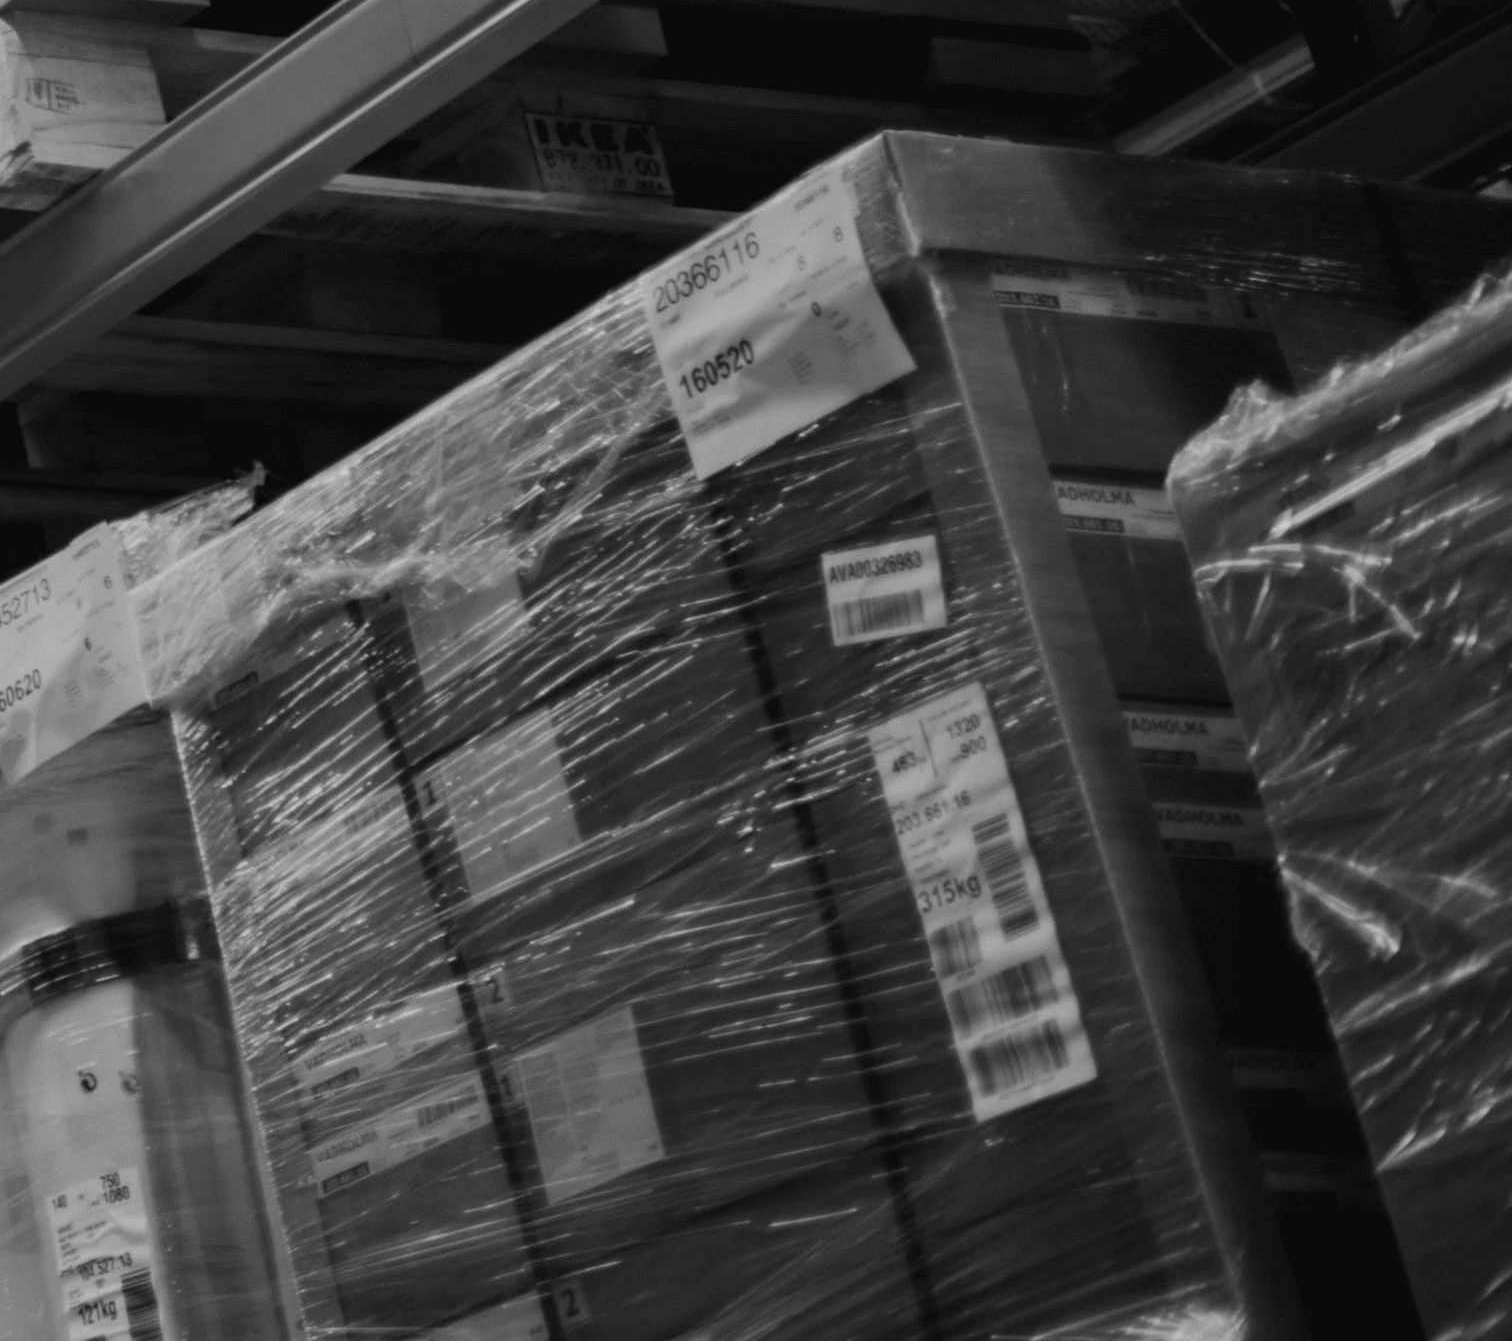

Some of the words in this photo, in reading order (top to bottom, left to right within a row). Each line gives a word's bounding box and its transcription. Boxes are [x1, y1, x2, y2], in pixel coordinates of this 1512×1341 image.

[533, 118, 657, 156] IKEA
[542, 148, 662, 179] 872.371.00
[653, 231, 761, 315] 20366116
[678, 338, 755, 400] 160520
[947, 713, 982, 742] 1320
[896, 789, 973, 836] 203.661.16
[918, 874, 984, 915] 315kg
[561, 1288, 581, 1319] 2
